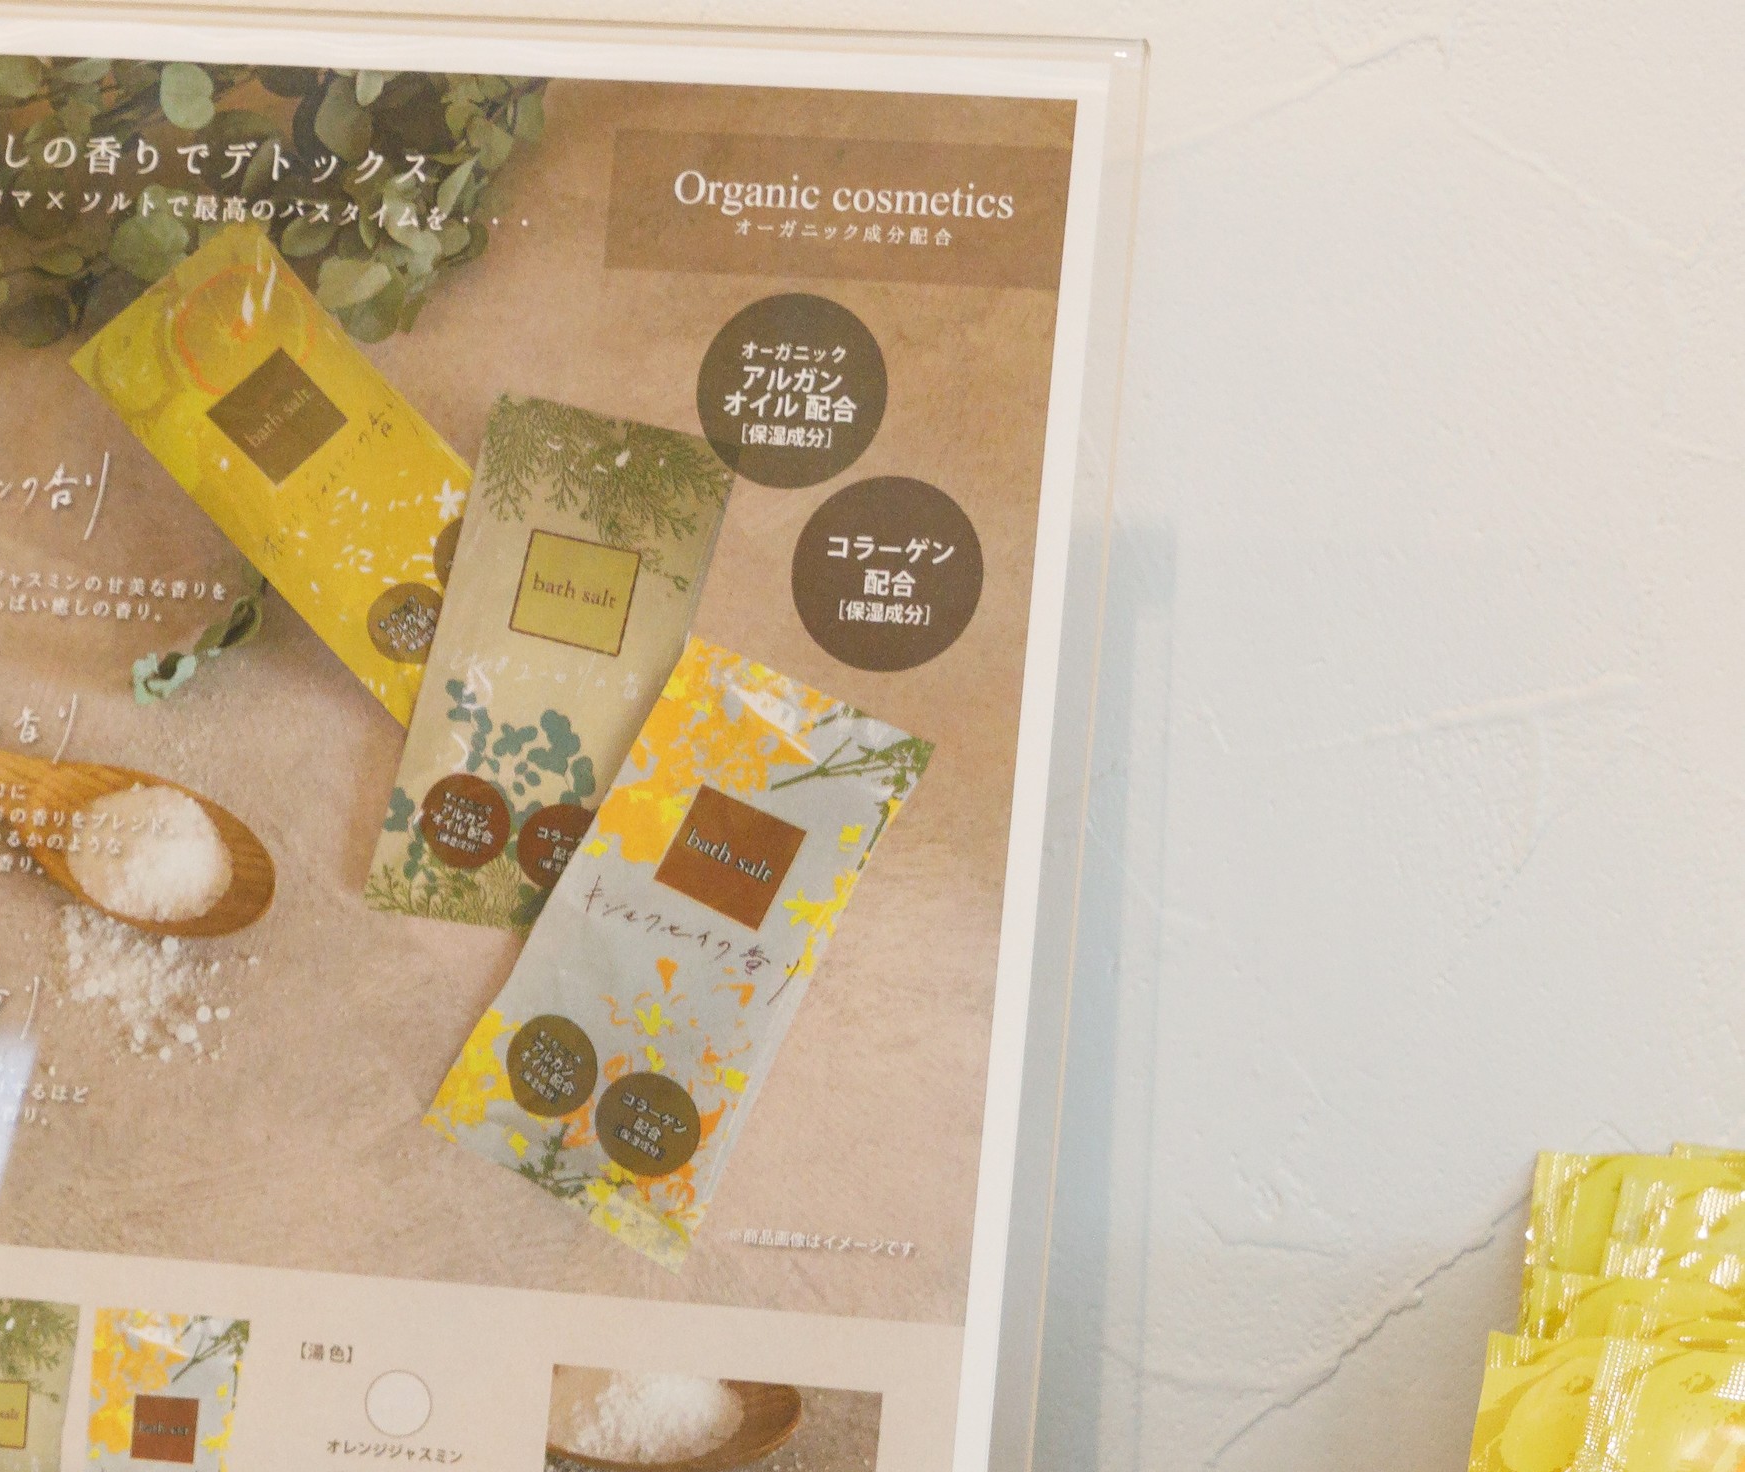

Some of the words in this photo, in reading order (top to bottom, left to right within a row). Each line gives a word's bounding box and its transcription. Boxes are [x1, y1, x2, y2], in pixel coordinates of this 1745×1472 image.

[674, 169, 820, 216] Organic
[832, 182, 1015, 219] cosmetics
[735, 219, 953, 246] オーガニック成分配合
[741, 342, 847, 363] オーガニック
[742, 365, 842, 393] アルガン
[827, 536, 954, 565] コラーゲン
[532, 571, 575, 600] bath
[583, 588, 616, 609] salt
[863, 569, 917, 598] 配合
[686, 827, 731, 866] bath
[735, 852, 774, 884] salt
[327, 1439, 462, 1464] オレンジジャスミン
